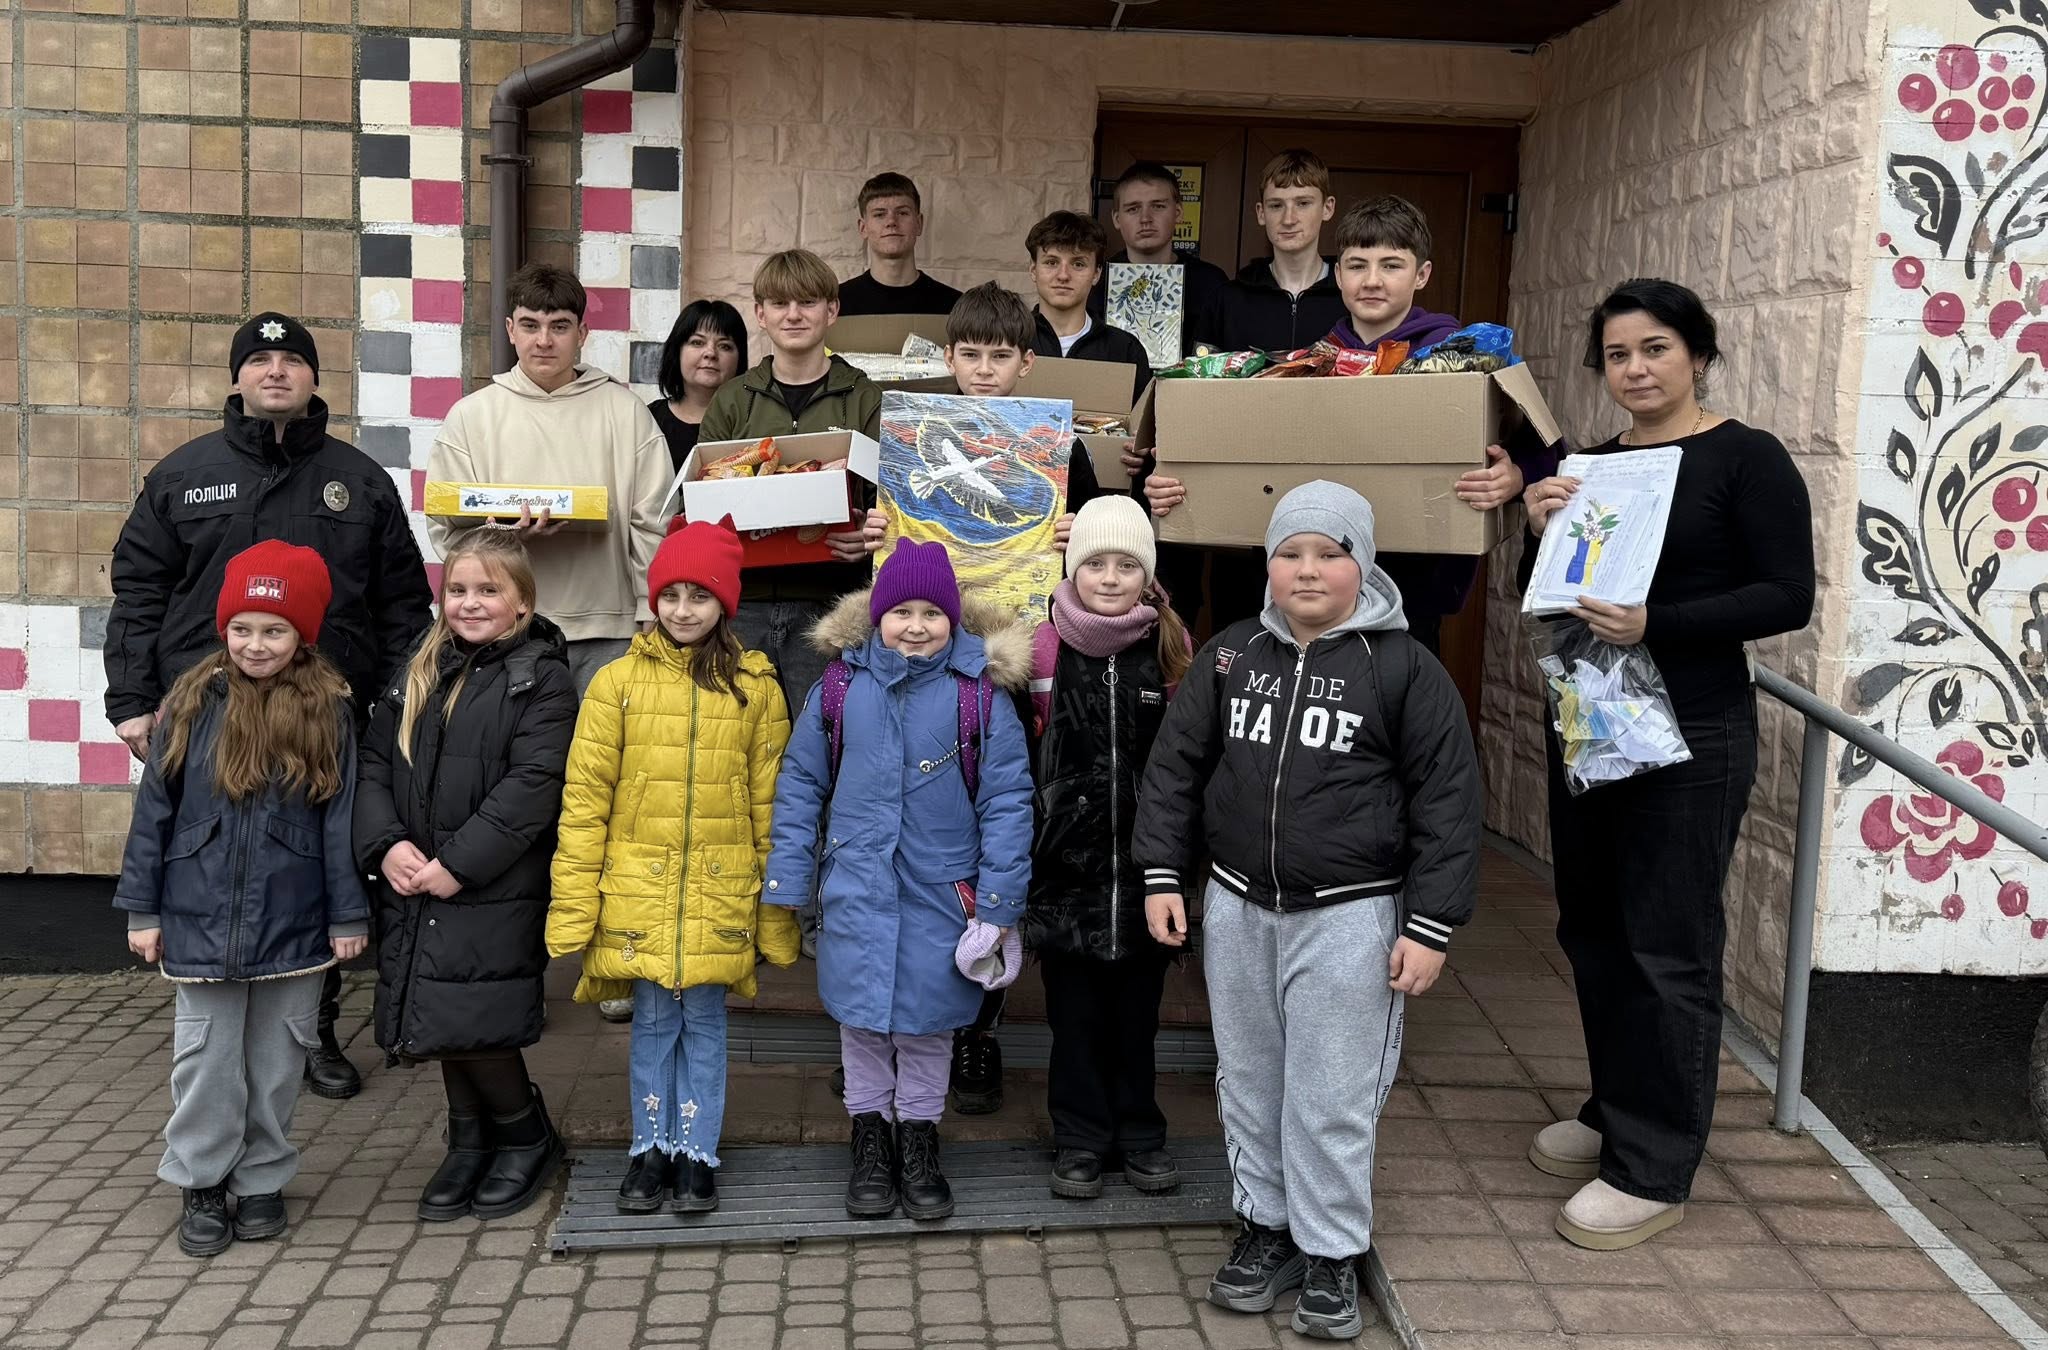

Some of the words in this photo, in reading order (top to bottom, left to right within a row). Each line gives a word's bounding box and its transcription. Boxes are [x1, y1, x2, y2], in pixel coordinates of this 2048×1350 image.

[1173, 241, 1196, 250] 9899
[184, 483, 237, 504] ПОЛІЦІЯ
[252, 578, 283, 589] JUST
[247, 585, 267, 597] DO
